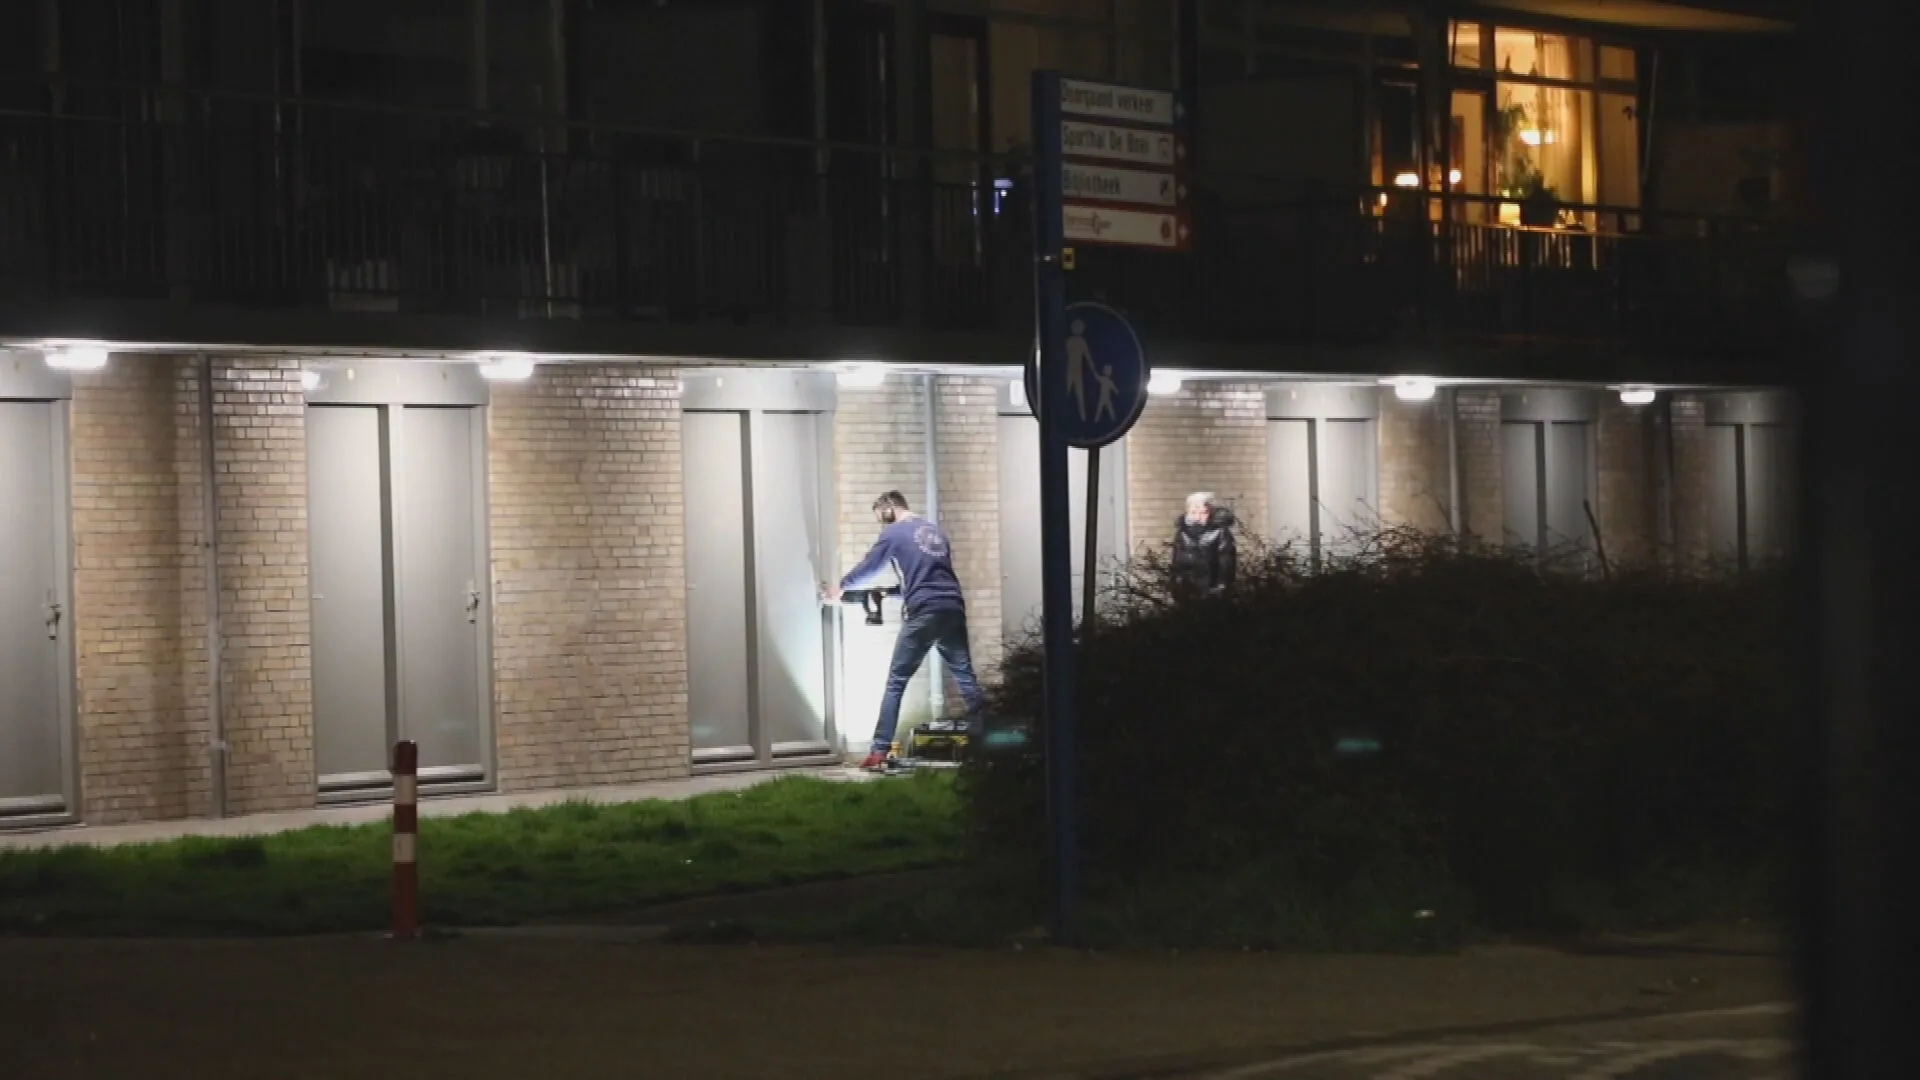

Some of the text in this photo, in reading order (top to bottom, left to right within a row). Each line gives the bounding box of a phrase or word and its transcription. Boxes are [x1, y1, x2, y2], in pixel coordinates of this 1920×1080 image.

[1117, 94, 1155, 113] verkeer
[1063, 125, 1106, 150] Sporthal
[1109, 129, 1122, 152] De
[1063, 169, 1120, 195] Bibliotheek
